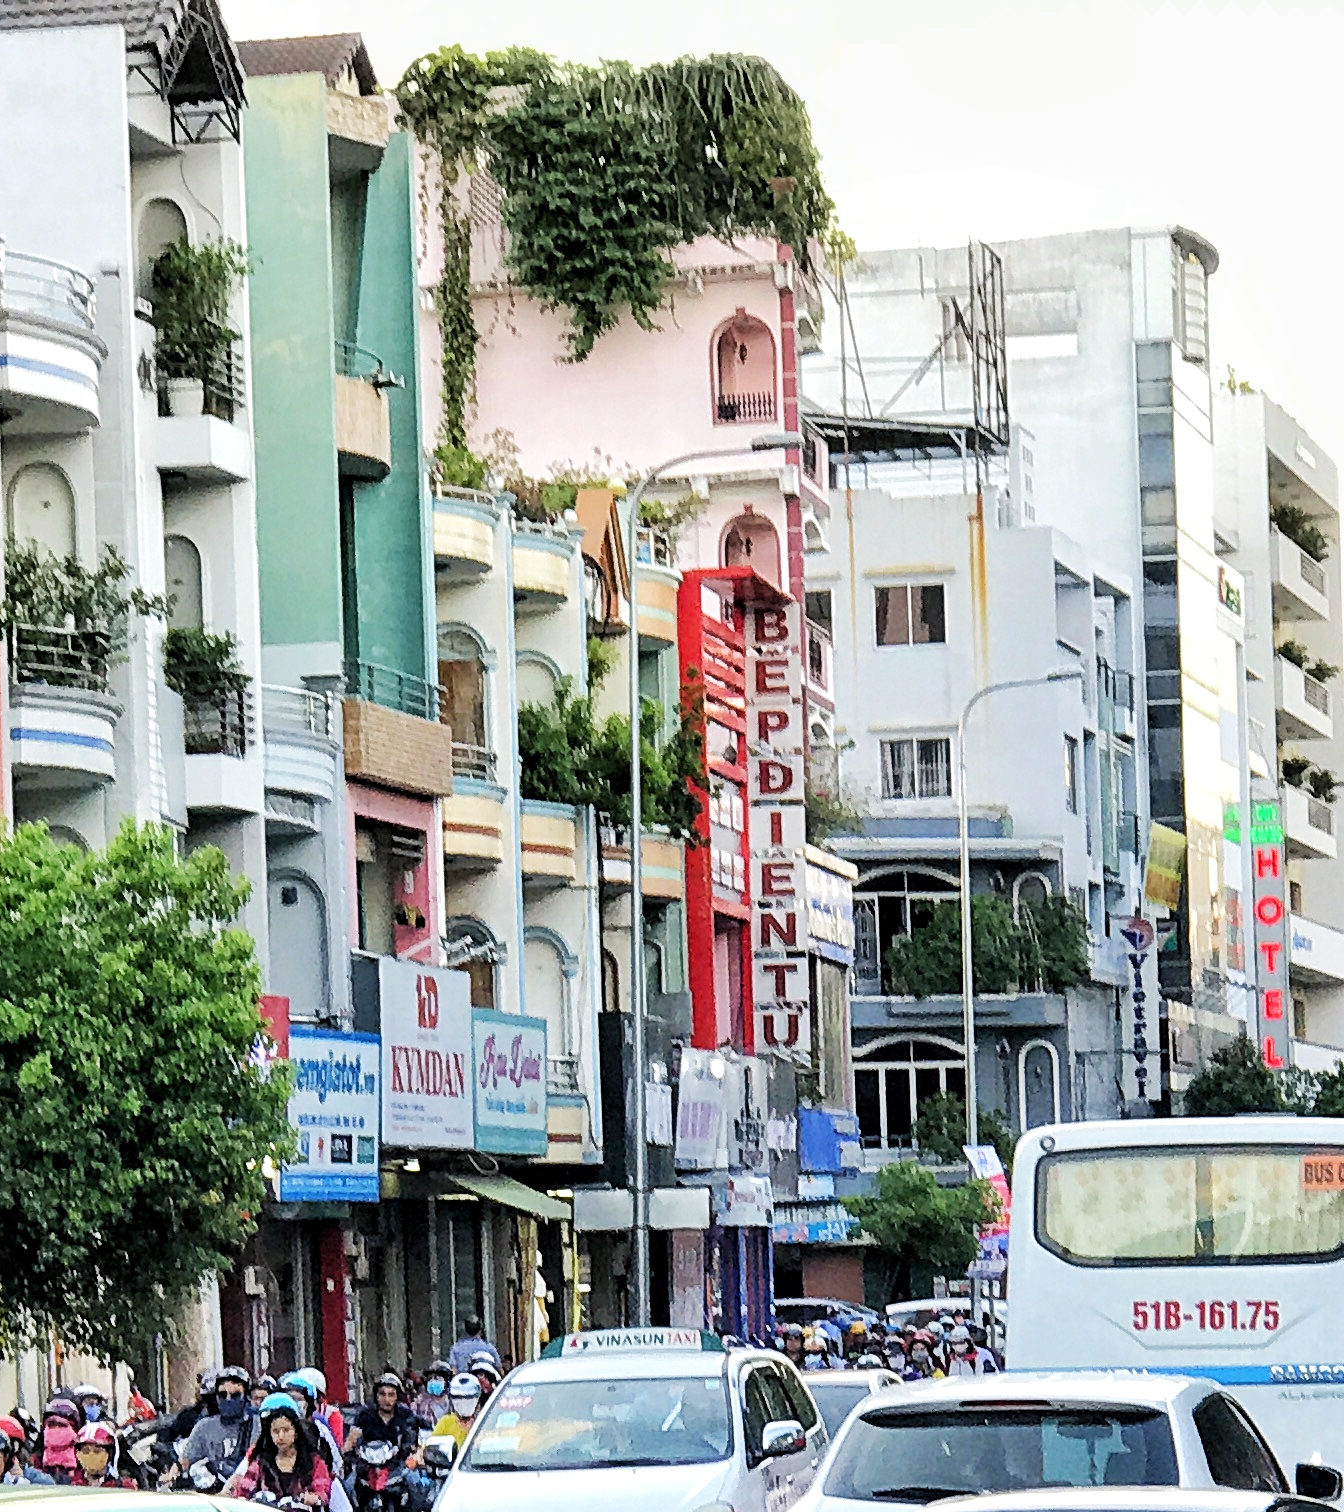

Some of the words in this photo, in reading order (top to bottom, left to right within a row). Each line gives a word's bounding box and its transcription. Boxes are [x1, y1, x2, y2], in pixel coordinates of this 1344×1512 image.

[1256, 847, 1285, 1069] HOTEL
[391, 1045, 465, 1099] KYMDAN
[1304, 1162, 1334, 1185] BUS
[1132, 1299, 1280, 1332] 51B-161.75
[596, 1331, 665, 1348] VINASUN
[666, 1331, 699, 1346] TAXI
